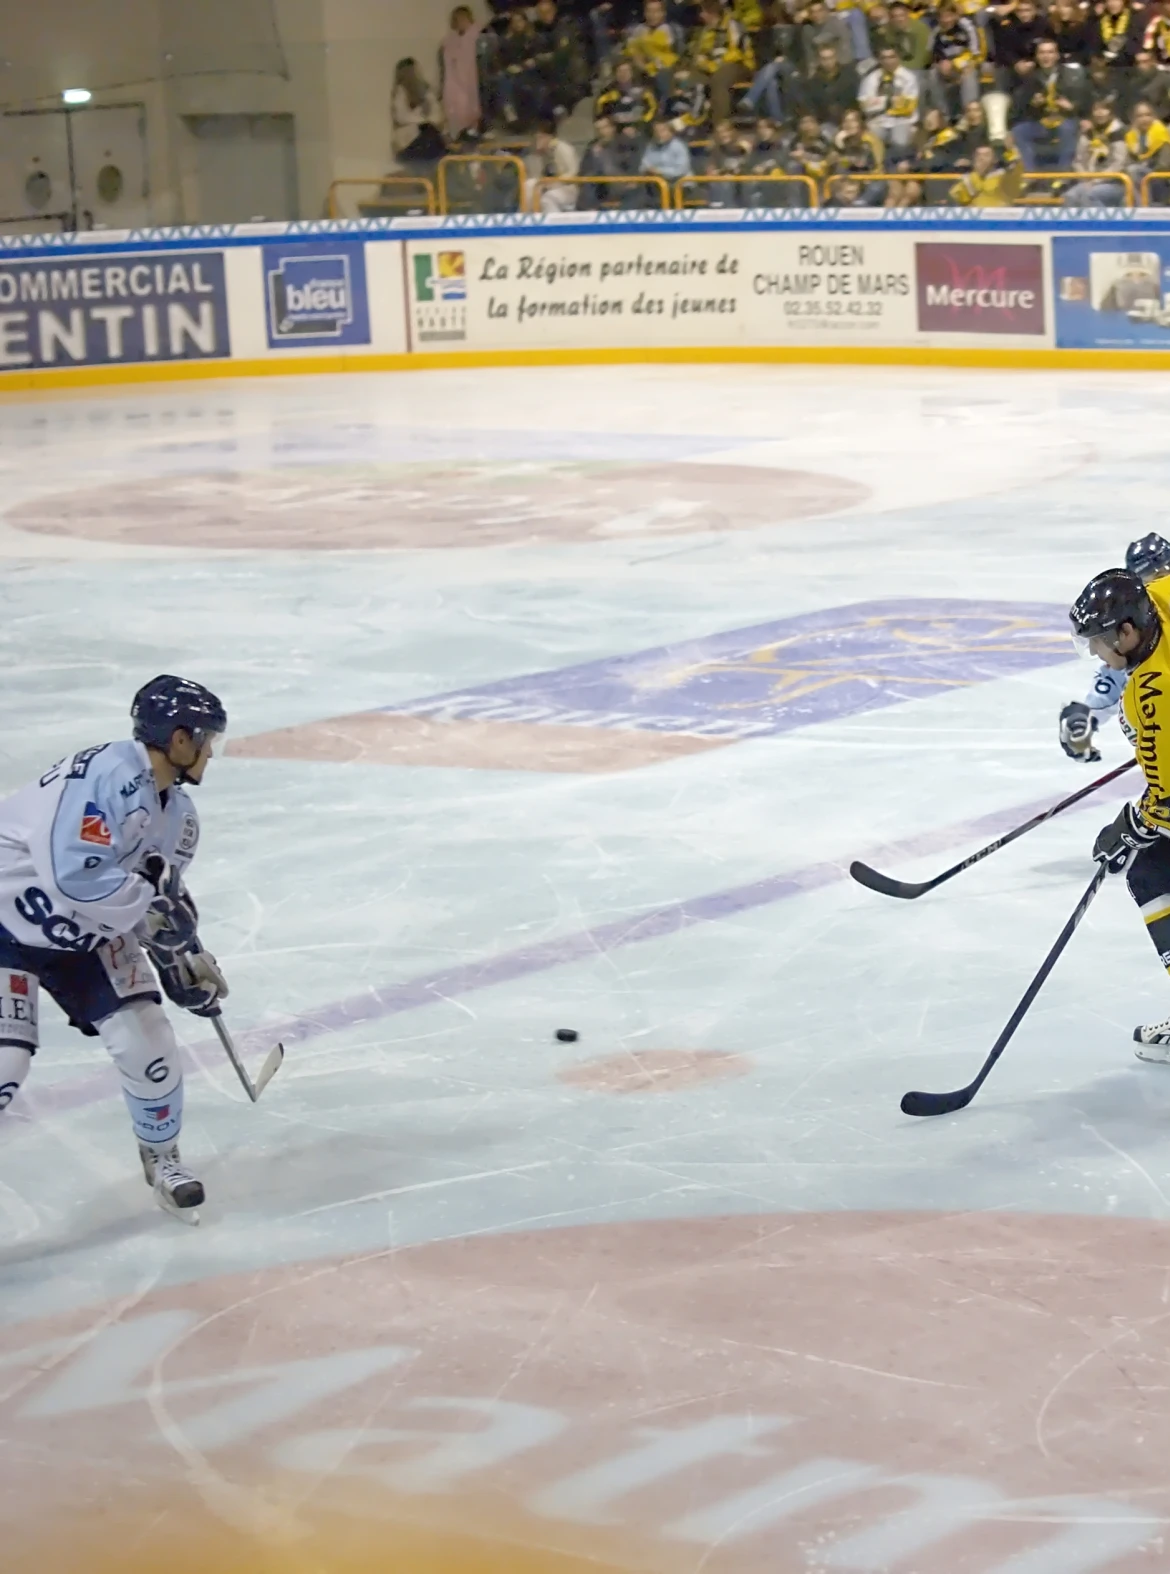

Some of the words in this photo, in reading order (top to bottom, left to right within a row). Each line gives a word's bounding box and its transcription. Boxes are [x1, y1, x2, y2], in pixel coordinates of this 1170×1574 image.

[479, 257, 508, 281] La
[516, 255, 592, 284] Région
[600, 253, 708, 282] partenaire
[715, 254, 740, 275] de
[799, 244, 864, 266] ROUEN
[286, 283, 347, 311] bleu
[753, 273, 821, 296] CHAMP
[827, 273, 852, 295] DE
[857, 273, 910, 296] MARS
[926, 284, 1035, 309] Mercure
[487, 297, 508, 319] la
[517, 295, 623, 323] formation
[630, 292, 664, 315] des
[671, 293, 737, 319] jeunes
[0, 301, 216, 364] ENTIN
[144, 1057, 169, 1083] 6
